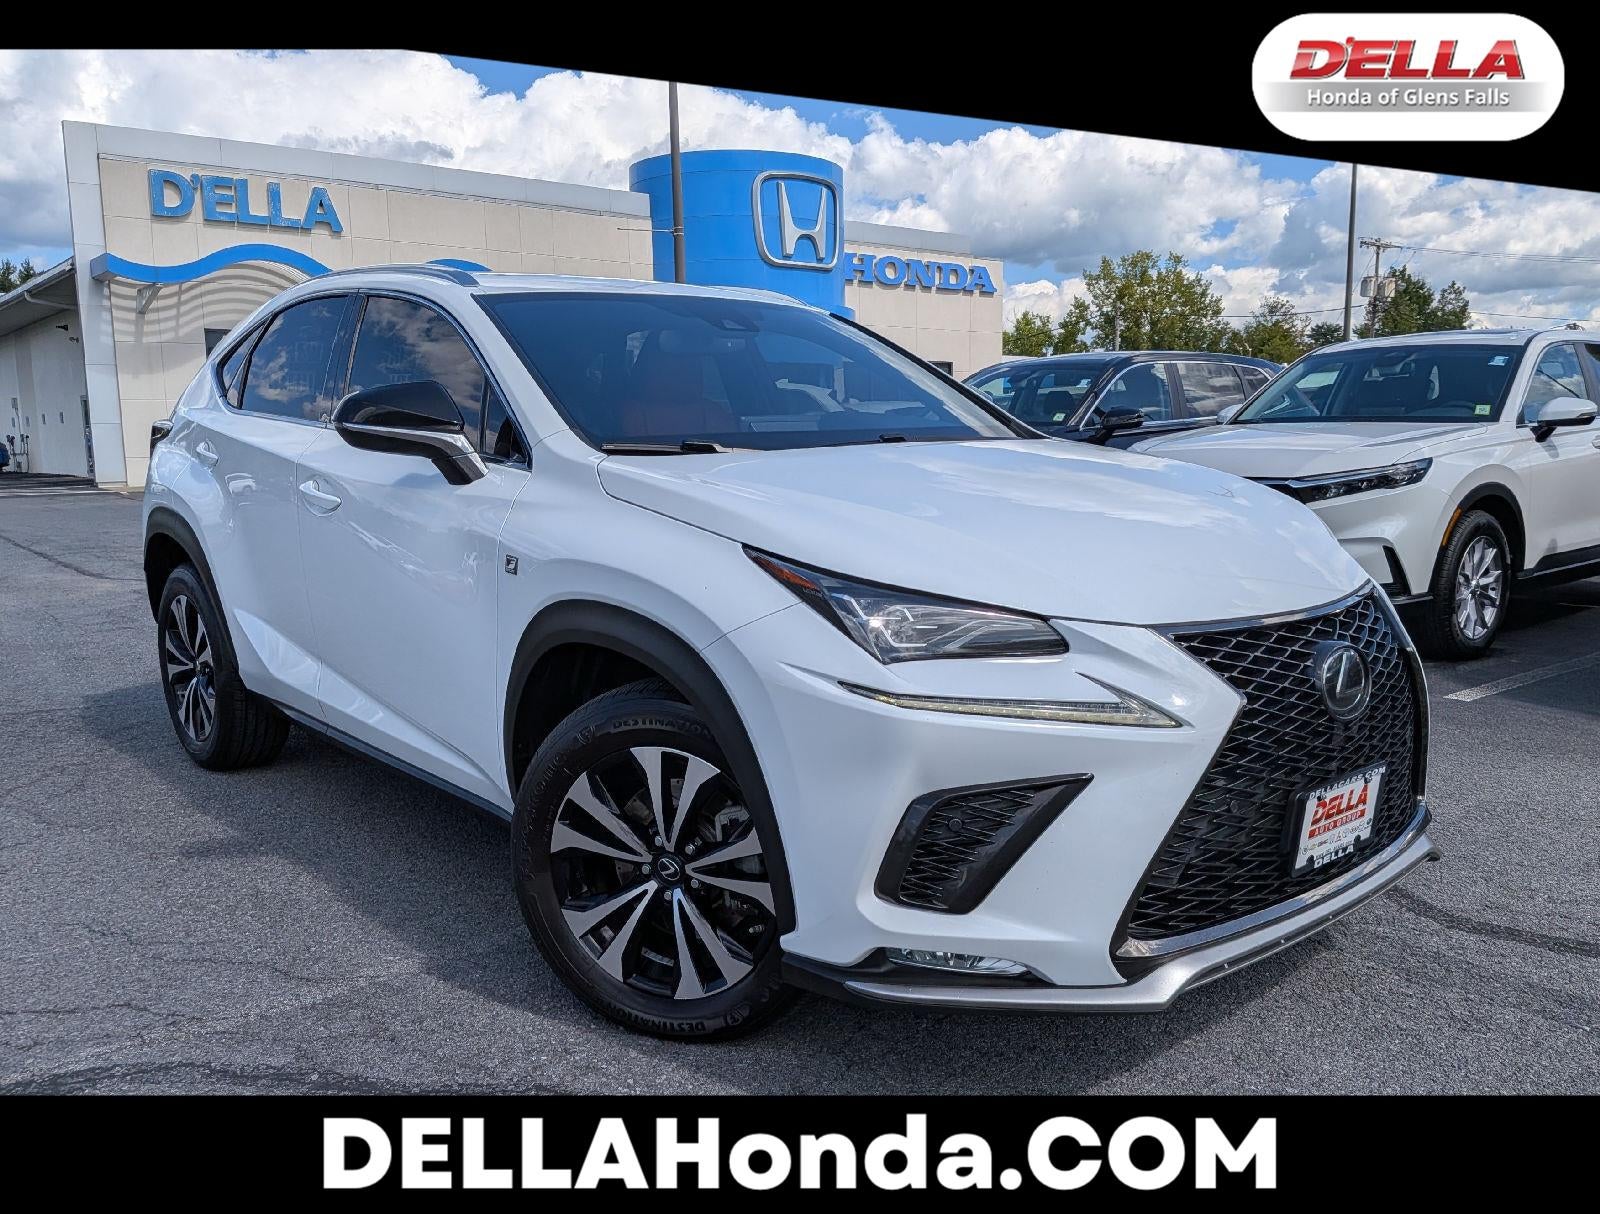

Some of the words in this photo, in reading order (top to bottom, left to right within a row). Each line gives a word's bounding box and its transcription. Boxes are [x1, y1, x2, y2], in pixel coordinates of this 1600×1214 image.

[148, 168, 344, 233] D'ELLA
[844, 251, 997, 293] HONDA
[1315, 822, 1335, 835] AUTO
[1336, 812, 1361, 829] GROUP
